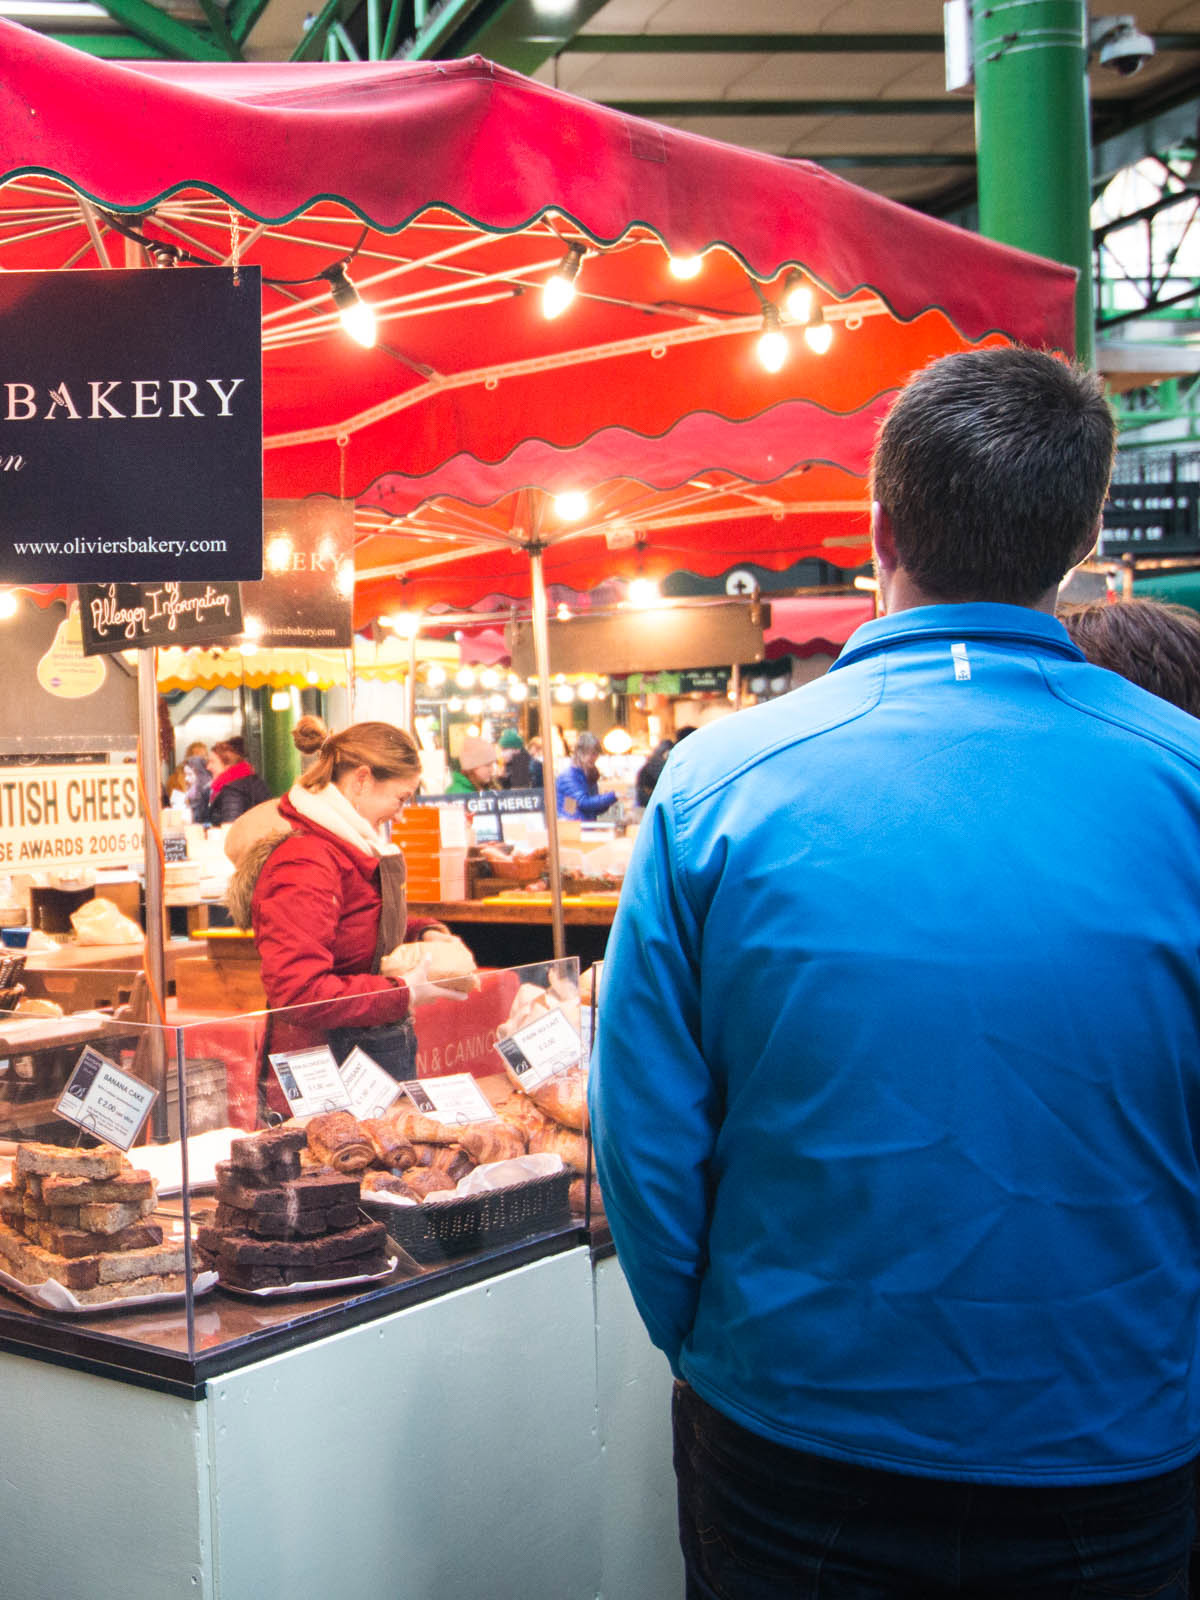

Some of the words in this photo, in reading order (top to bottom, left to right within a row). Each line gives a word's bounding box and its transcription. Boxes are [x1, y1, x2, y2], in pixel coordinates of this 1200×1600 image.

[4, 379, 246, 421] BAKERY
[13, 536, 228, 556] www.oliviersbakery.com
[273, 552, 345, 572] ERY
[90, 598, 150, 638] Allergen
[145, 585, 230, 631] Information
[467, 798, 495, 812] GET
[497, 796, 540, 811] HERE?
[19, 836, 84, 860] AWARDS
[431, 1047, 441, 1072] &
[103, 1073, 128, 1094] BANANA
[128, 1088, 145, 1104] CAKE
